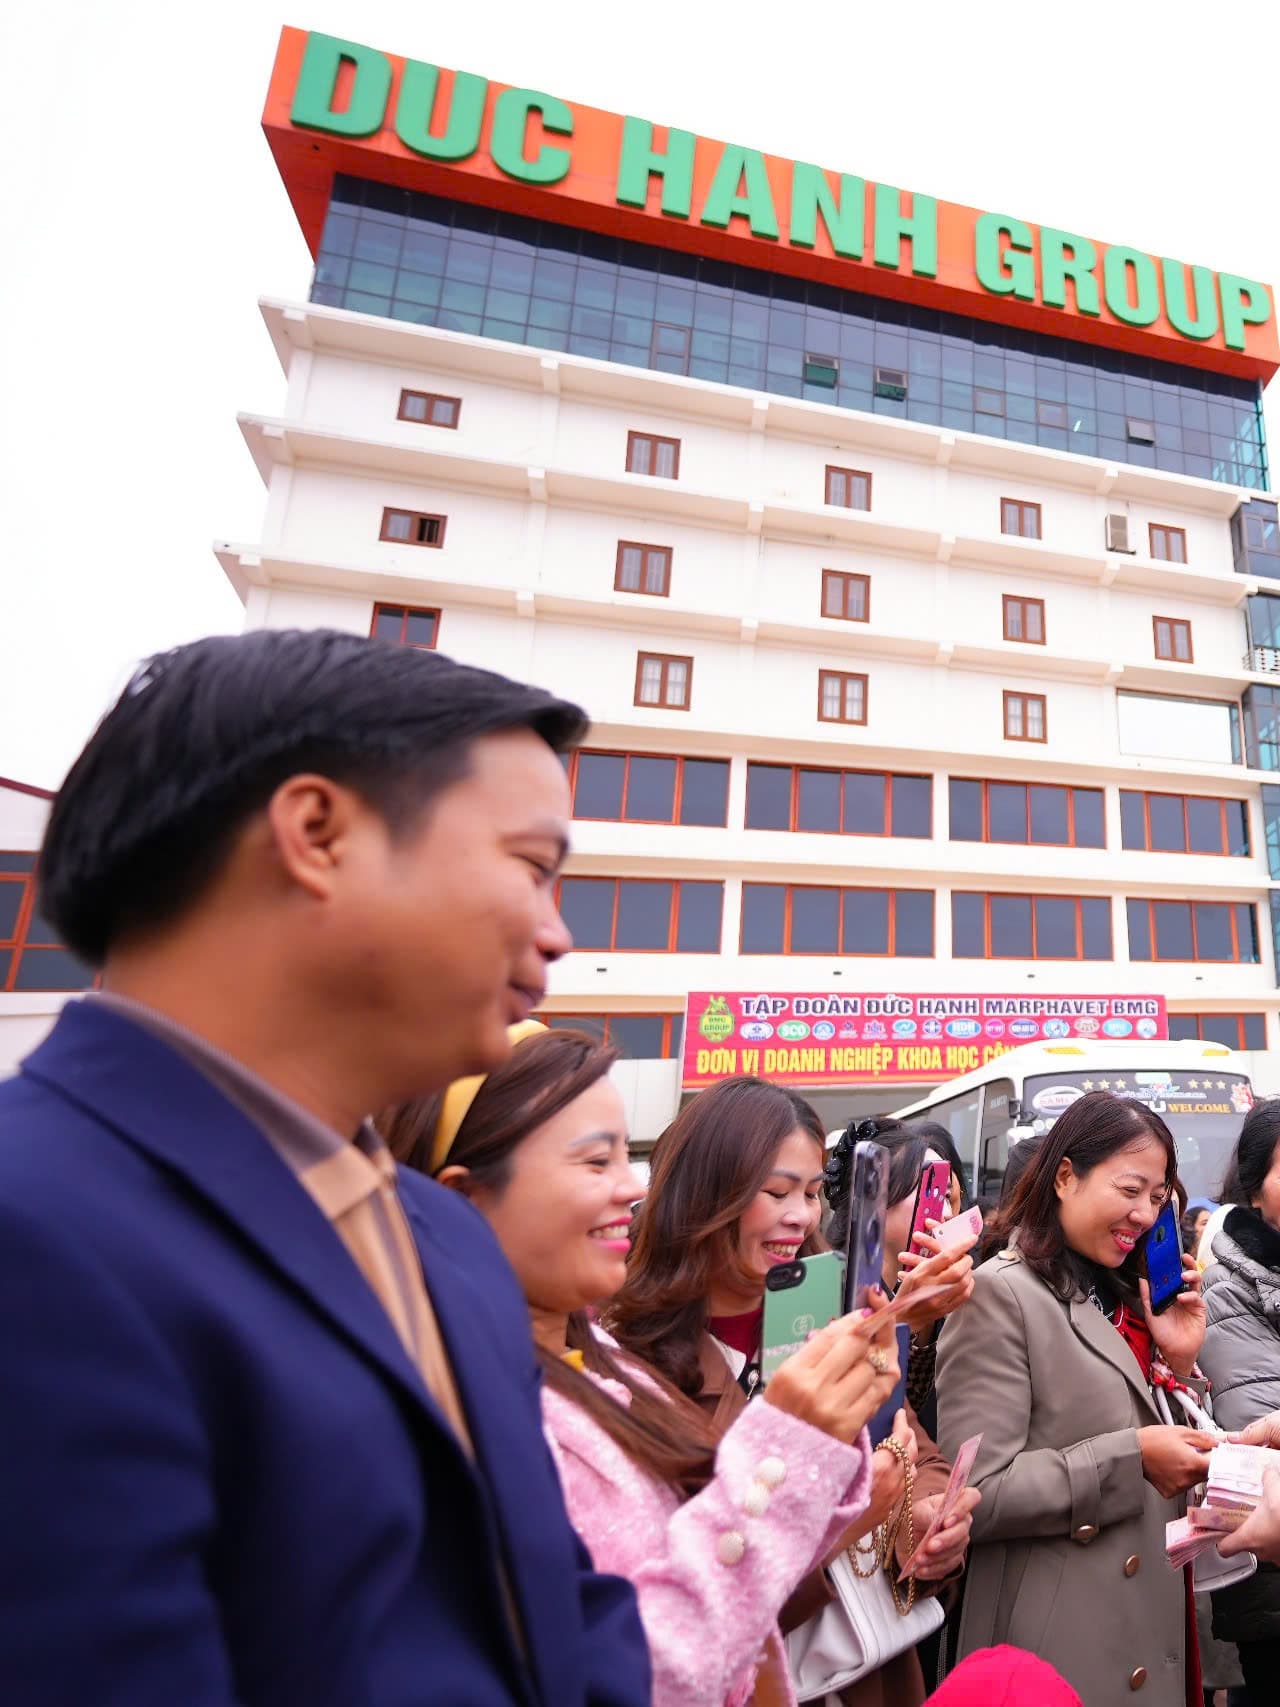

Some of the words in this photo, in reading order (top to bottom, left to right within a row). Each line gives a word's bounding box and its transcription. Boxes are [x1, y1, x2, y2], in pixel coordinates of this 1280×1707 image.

[290, 31, 574, 186] DUC
[616, 115, 938, 280] HANH
[975, 211, 1271, 352] GROUP
[741, 995, 787, 1020] TẬP
[794, 995, 859, 1016] ĐOÀN
[866, 994, 912, 1016] ĐỨC
[918, 998, 979, 1018] HẠNH
[984, 998, 1108, 1016] MARPHAVET
[1112, 999, 1158, 1016] BMG
[697, 1048, 736, 1074] ĐƠN
[742, 1049, 760, 1077] VỊ
[764, 1048, 826, 1074] DOANH
[830, 1042, 894, 1076] NGHIỆP
[898, 1046, 943, 1071] KHOA
[946, 1045, 979, 1074] HỌC
[1168, 1103, 1232, 1113] WELCOME
